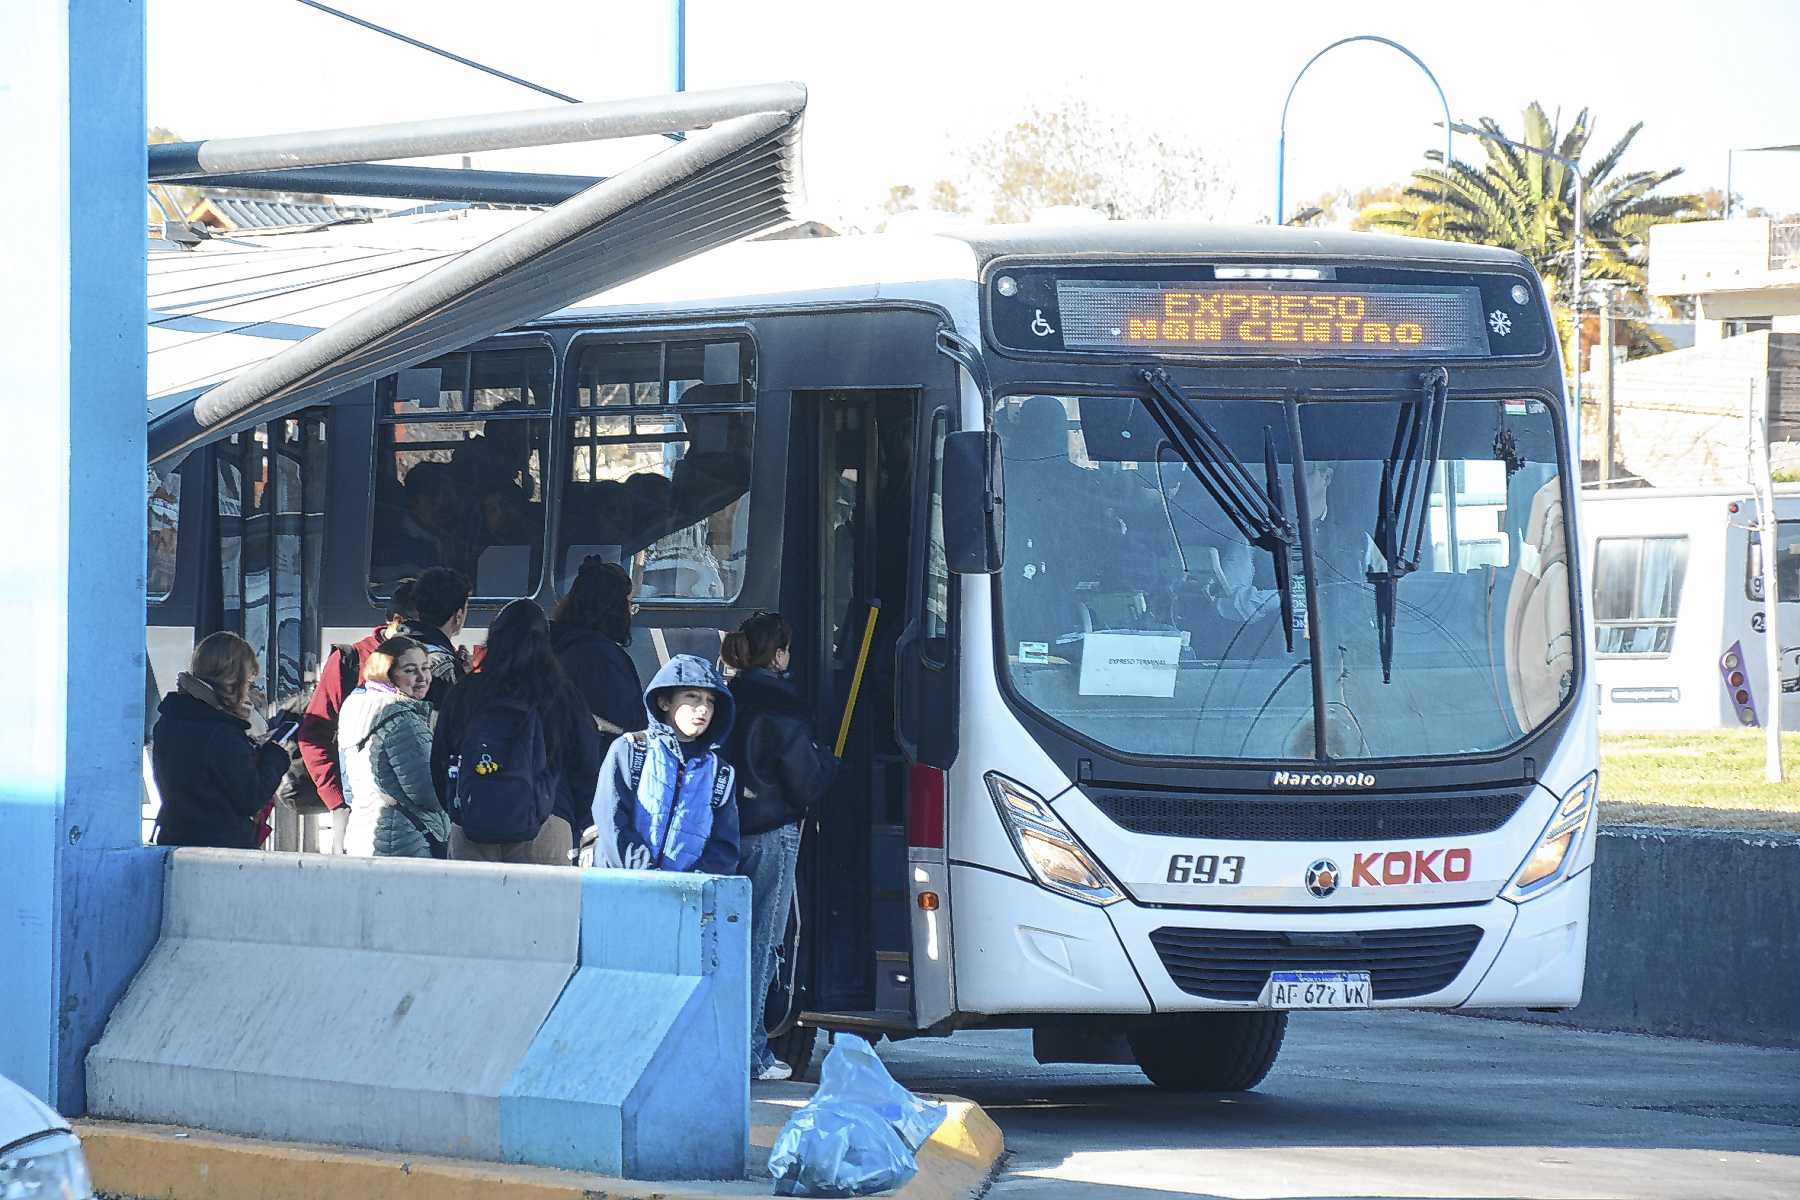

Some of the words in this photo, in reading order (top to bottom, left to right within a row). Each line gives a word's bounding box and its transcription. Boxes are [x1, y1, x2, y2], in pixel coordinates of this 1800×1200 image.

[1163, 293, 1365, 320] EXPRESO
[1239, 320, 1424, 345] CENTRO
[1108, 657, 1136, 666] EXPRESO
[1136, 657, 1167, 666] TERMINAL
[1273, 771, 1376, 788] Marcopolo
[1166, 854, 1246, 885] 693
[1351, 847, 1472, 888] KOKO
[1275, 983, 1299, 1005] AF
[1304, 983, 1337, 1005] 677
[1344, 983, 1365, 1004] VK
